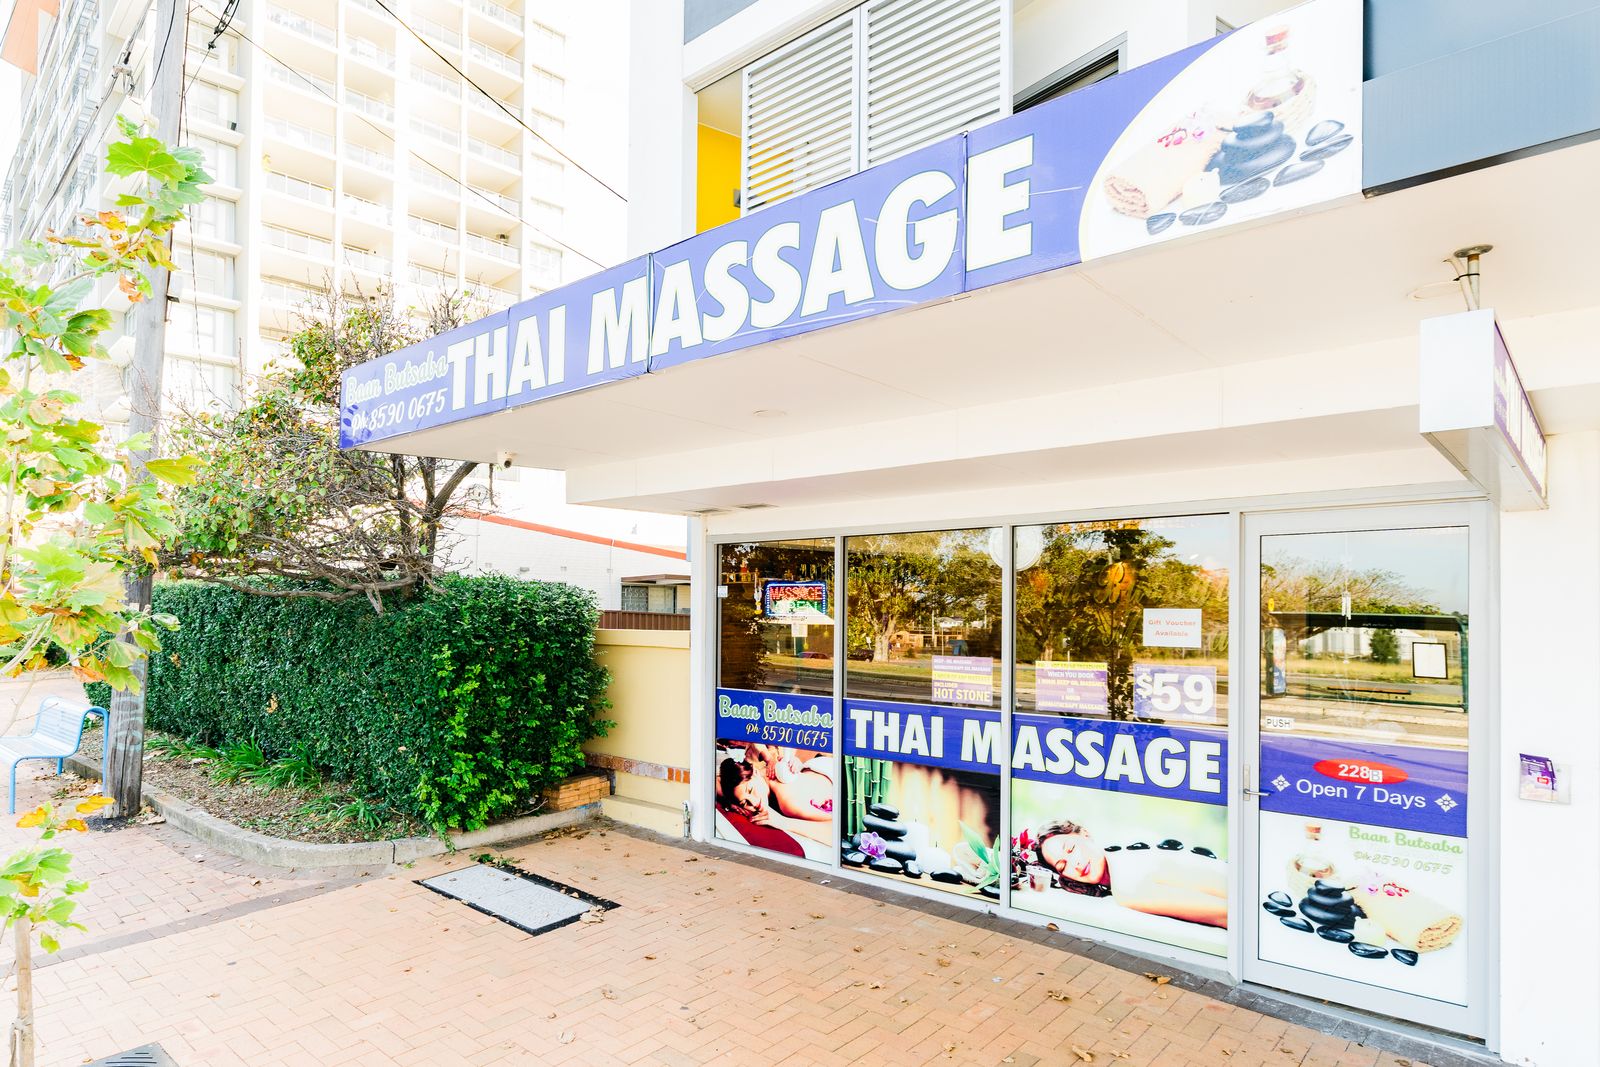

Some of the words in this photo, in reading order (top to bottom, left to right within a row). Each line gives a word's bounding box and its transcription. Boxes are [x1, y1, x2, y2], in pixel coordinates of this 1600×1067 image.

[448, 305, 566, 410] THAI
[587, 133, 1034, 375] MASSAGE
[346, 376, 382, 407] Baan
[384, 350, 449, 395] Butsaba
[369, 401, 405, 431] 8590
[408, 387, 448, 420] 0675
[770, 586, 823, 600] MASSAGE
[934, 687, 954, 700] HOT
[956, 689, 990, 703] STONE
[1135, 672, 1214, 715] $59
[719, 695, 761, 720] Baan
[763, 698, 834, 729] Butsaba
[1266, 718, 1291, 728] PUSH
[762, 725, 793, 743] 8590
[796, 729, 830, 748] 0675
[850, 708, 944, 758] THAI
[960, 718, 1221, 794] MASSAGE
[1296, 778, 1348, 798] Open
[1354, 785, 1367, 800] 7
[1373, 787, 1427, 809] Days
[1349, 826, 1390, 845] Baan
[1394, 831, 1463, 855] Butsaba
[1371, 852, 1410, 869] 8590
[1413, 859, 1453, 875] 0675
